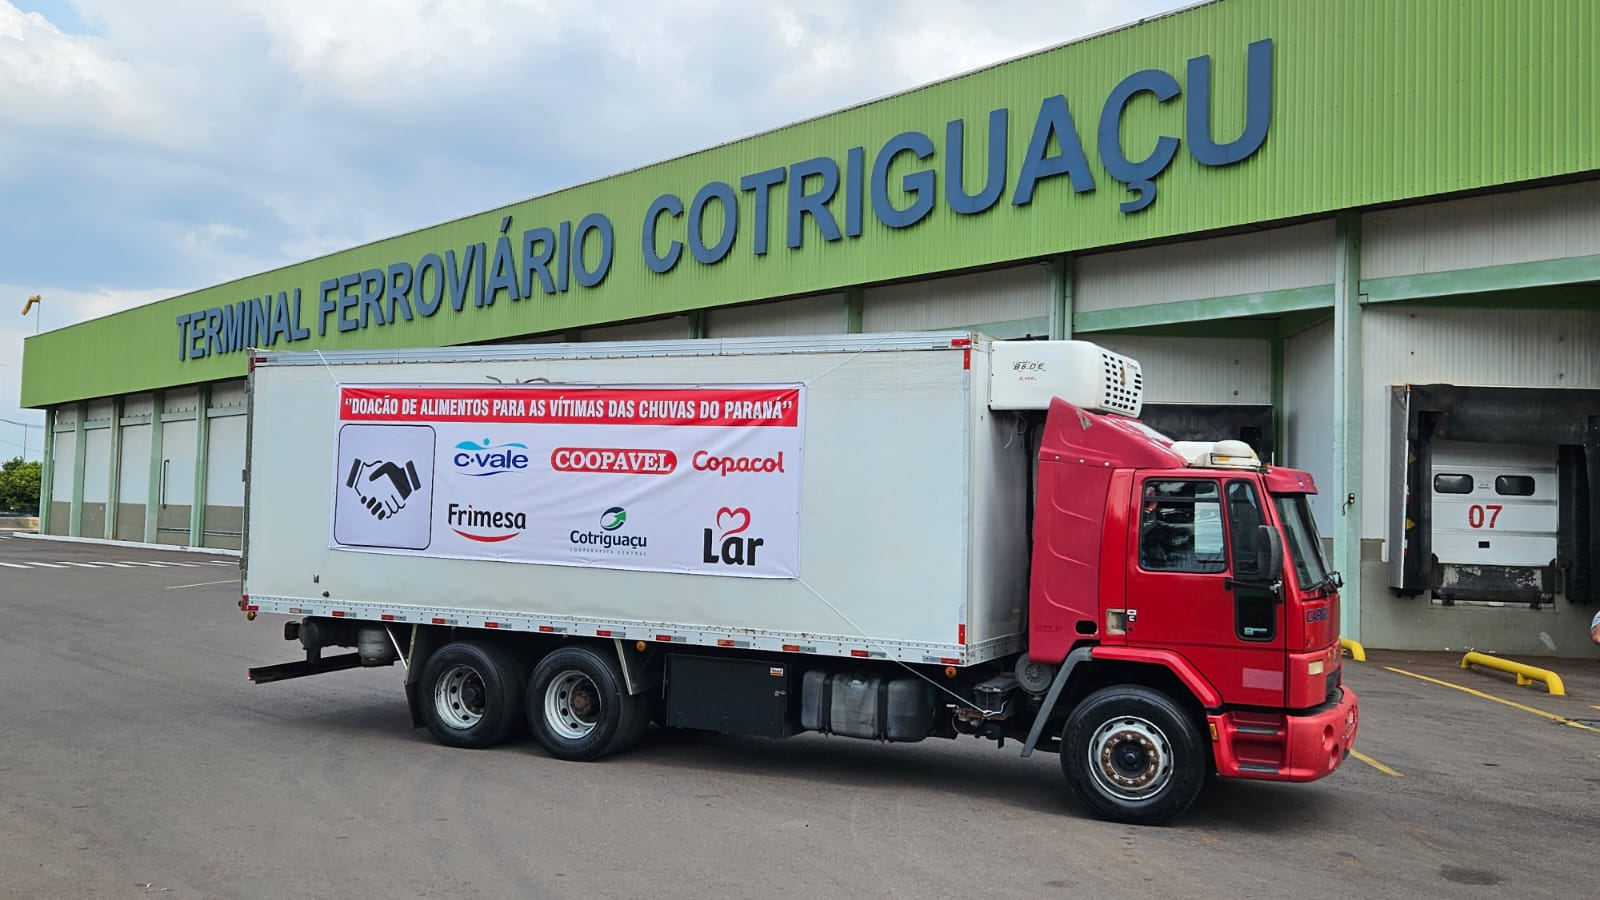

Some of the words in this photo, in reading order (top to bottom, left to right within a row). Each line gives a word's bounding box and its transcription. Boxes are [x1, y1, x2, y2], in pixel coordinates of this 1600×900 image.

[175, 287, 310, 362] TERMINAL
[318, 215, 615, 336] FERROVIÁRIO
[641, 38, 1273, 274] COTRIGUAÇU
[401, 398, 417, 415] DE
[420, 399, 489, 417] ALIMENTOS
[492, 399, 526, 417] PARA
[528, 399, 546, 417] AS
[549, 395, 604, 418] VÍTIMAS
[608, 399, 635, 418] DAS
[638, 400, 696, 419] CHUVAS
[699, 400, 720, 419] DO
[555, 450, 673, 472] COOPAVEL
[692, 450, 785, 477] Copacol
[447, 503, 527, 530] Frimesa
[1467, 504, 1504, 529] 07
[570, 530, 647, 550] Cotriguaçu
[703, 527, 765, 566] Lar
